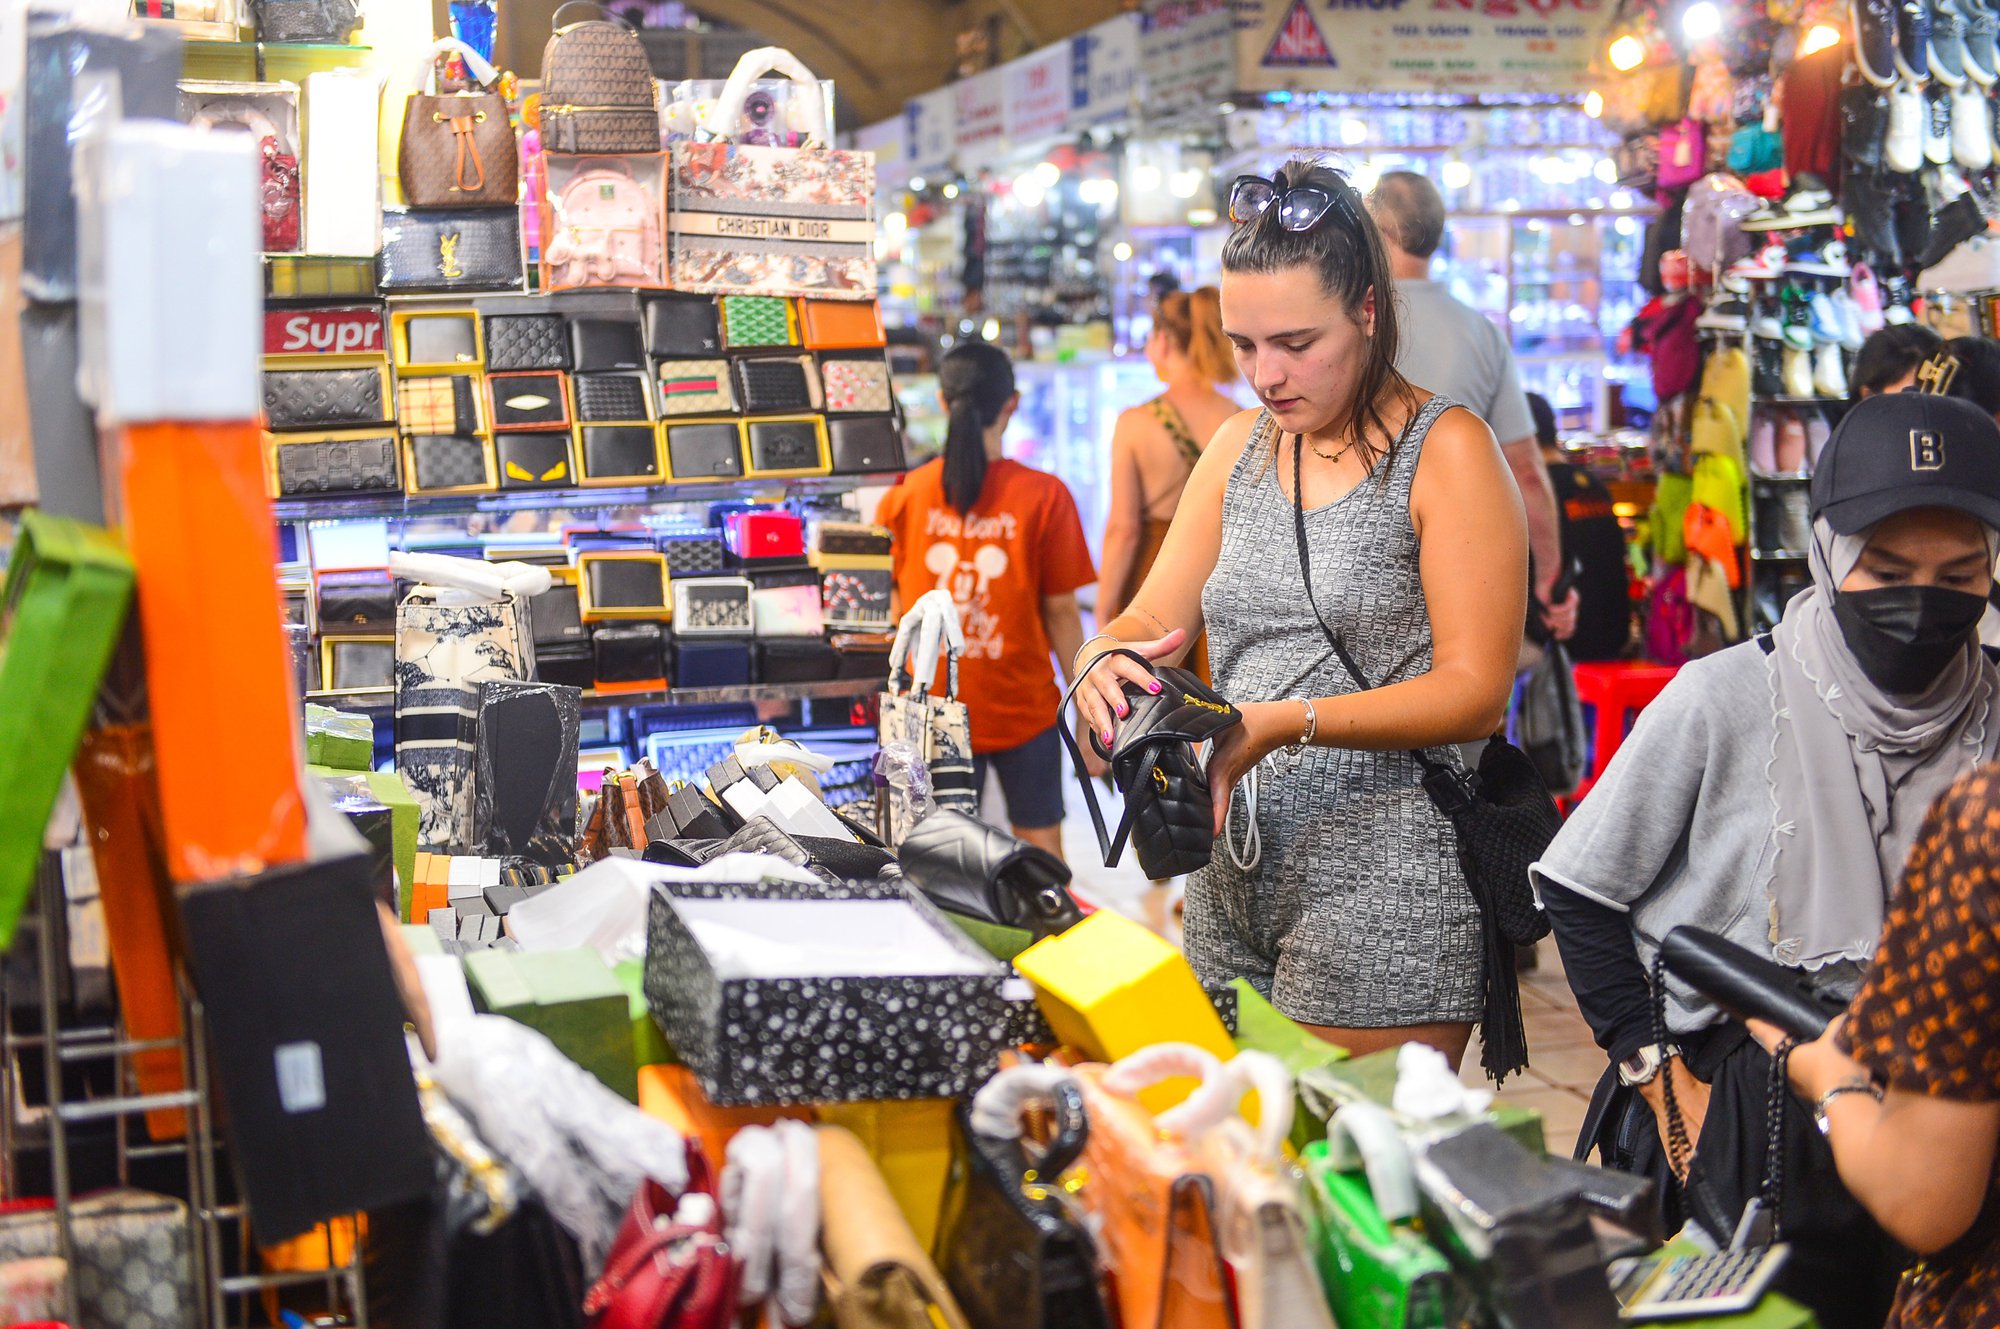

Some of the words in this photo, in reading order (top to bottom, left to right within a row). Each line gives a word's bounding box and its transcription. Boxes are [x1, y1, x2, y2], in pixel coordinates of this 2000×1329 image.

[716, 217, 791, 237] CHRISTIAN
[797, 222, 831, 239] DIOR
[282, 315, 381, 354] Supr
[1909, 429, 1946, 472] B
[925, 507, 962, 538] You
[963, 510, 1018, 540] Don't
